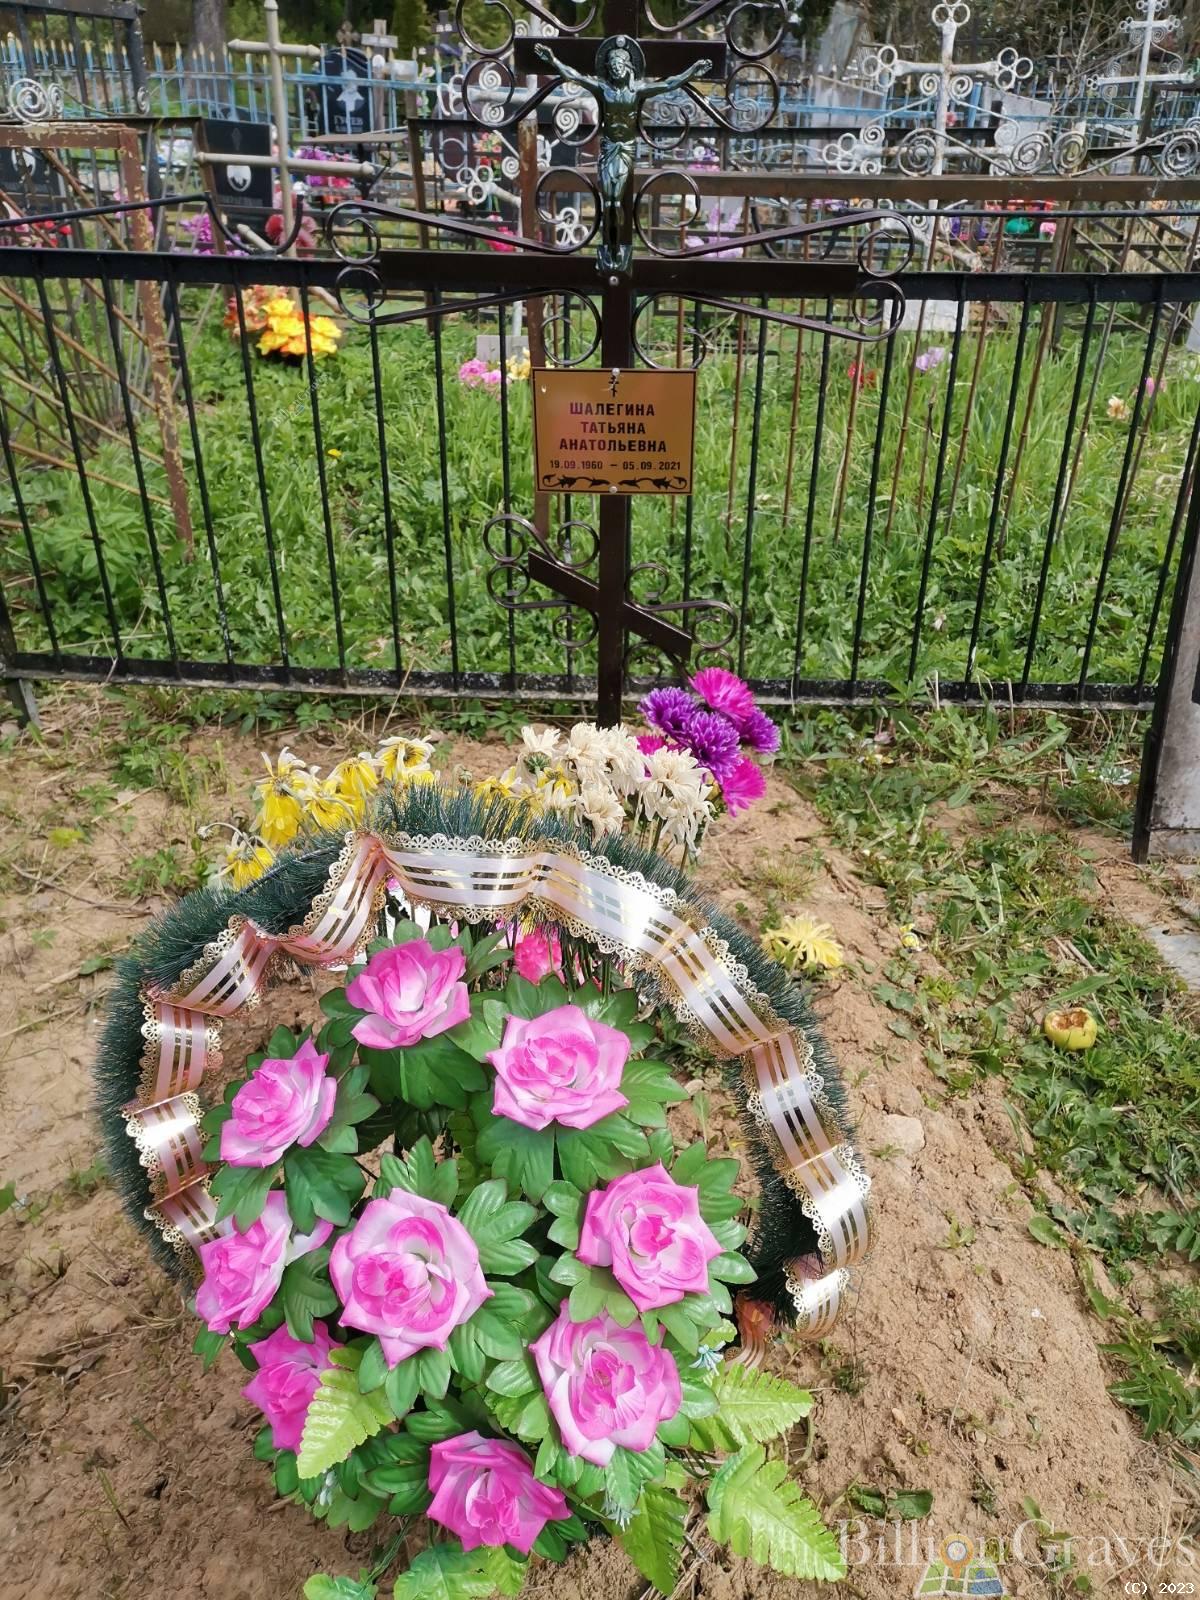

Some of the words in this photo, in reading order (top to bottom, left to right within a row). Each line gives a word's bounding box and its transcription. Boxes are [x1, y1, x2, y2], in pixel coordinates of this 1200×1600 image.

[570, 402, 655, 416] ШАЛЕГИНА
[581, 421, 646, 434] ТАТЬЯНА
[559, 438, 667, 453] АНАТОЛЬЕВНА
[550, 460, 603, 470] 19.09.1960
[622, 461, 681, 470] 05.09.2021
